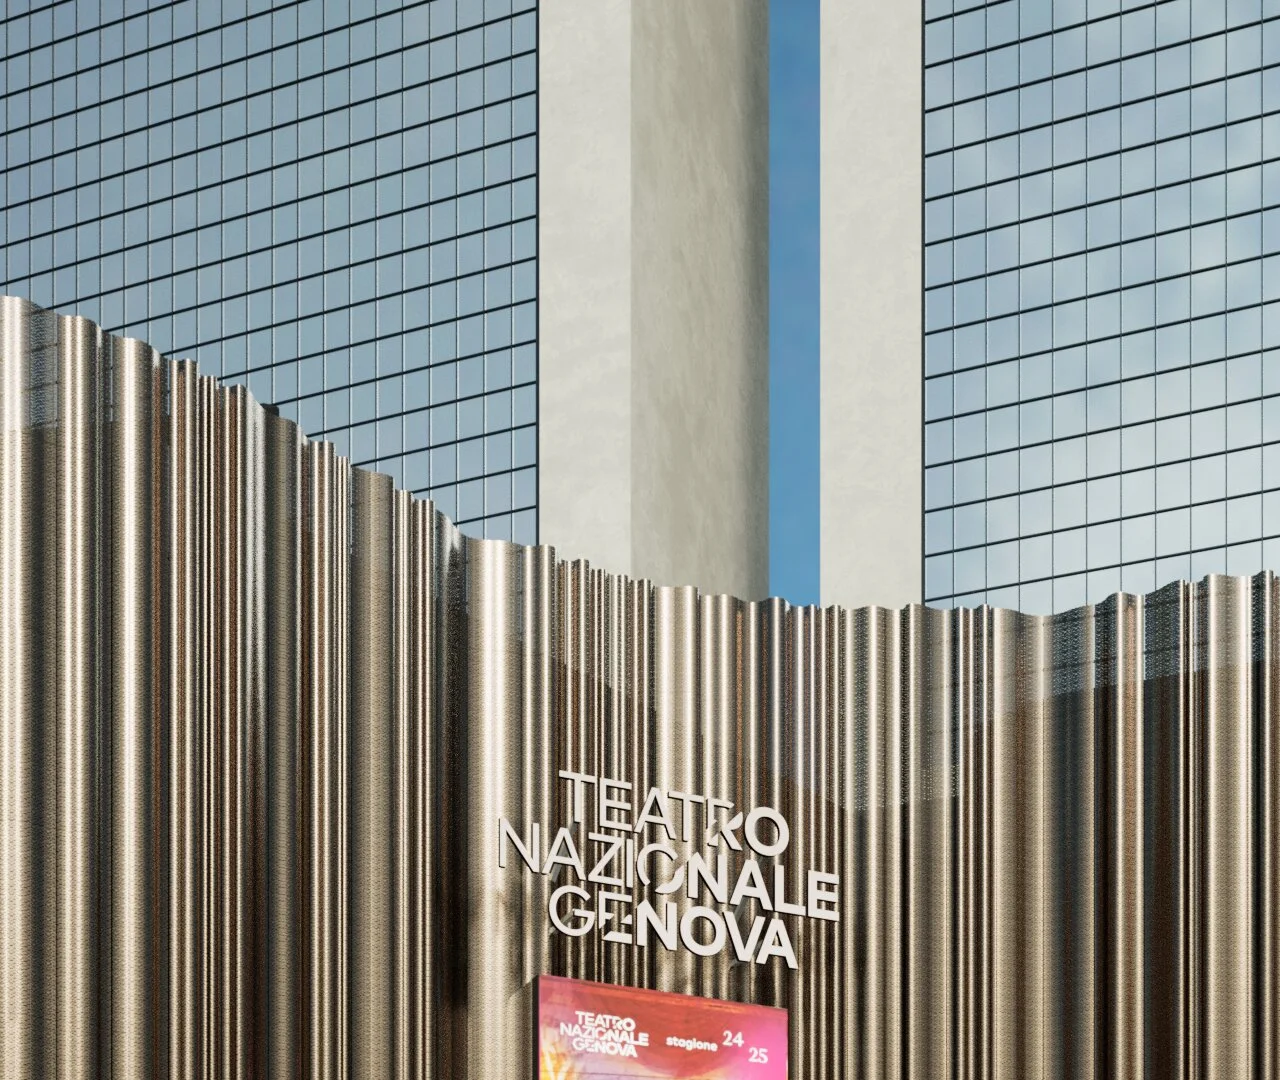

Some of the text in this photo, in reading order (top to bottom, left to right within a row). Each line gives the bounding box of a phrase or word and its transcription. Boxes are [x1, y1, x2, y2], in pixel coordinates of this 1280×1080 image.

[558, 769, 790, 857] TEATRO
[498, 817, 840, 922] NAZIONALE
[548, 884, 799, 970] GENOVA
[574, 1010, 637, 1033] TEATRO
[559, 1021, 650, 1047] NAZIONALE
[665, 1030, 745, 1052] stagione 24
[572, 1037, 638, 1058] GENOVA
[748, 1047, 769, 1064] 25
